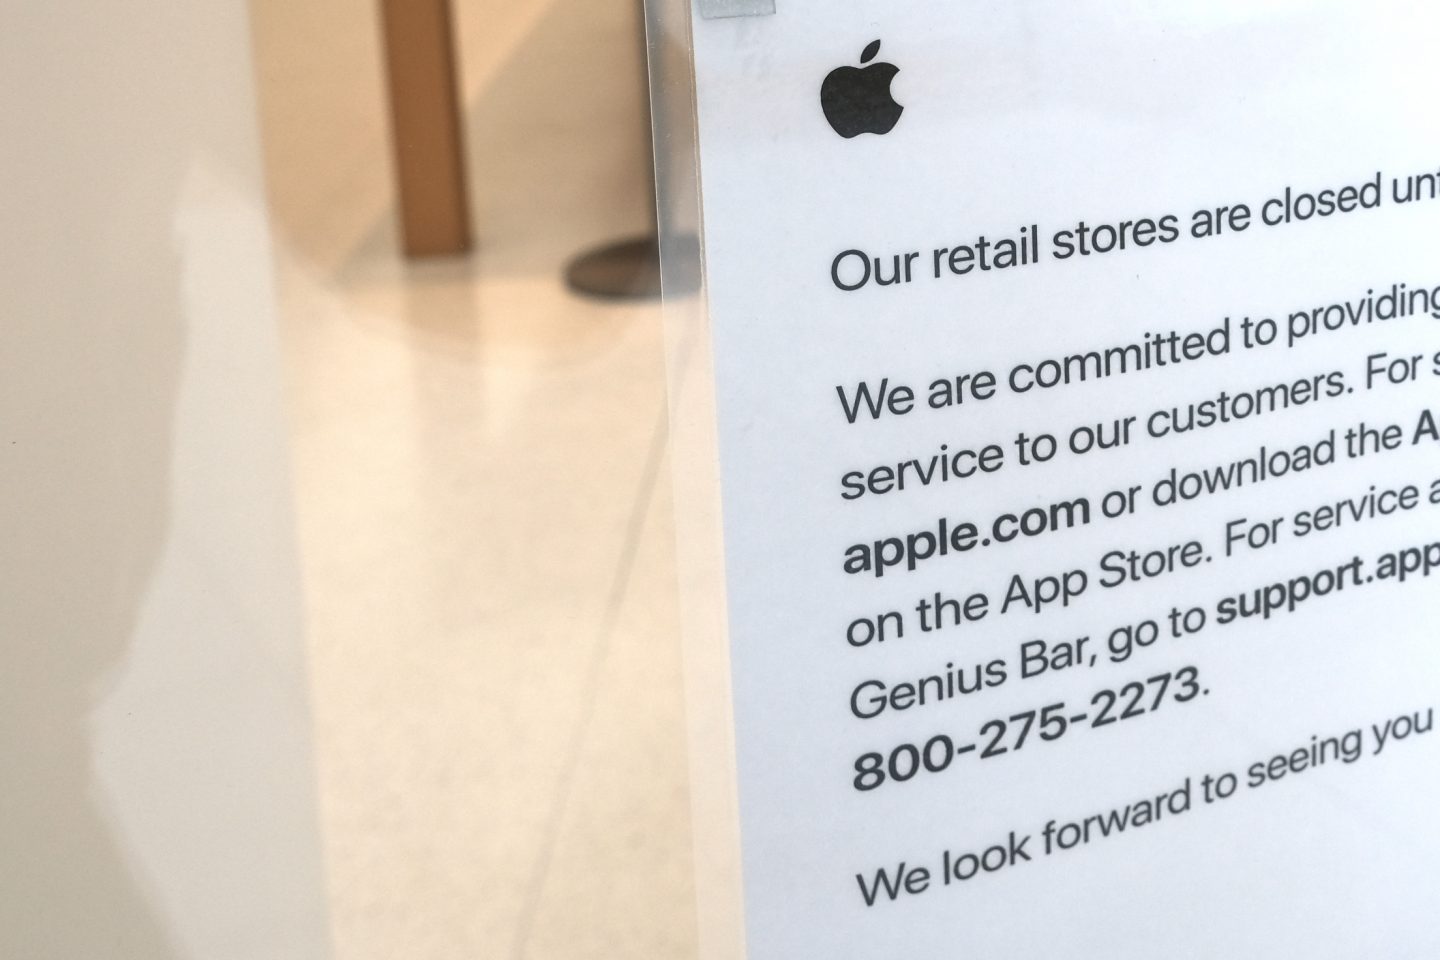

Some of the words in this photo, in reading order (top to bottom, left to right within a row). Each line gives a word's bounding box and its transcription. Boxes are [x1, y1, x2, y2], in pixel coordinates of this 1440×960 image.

[830, 248, 920, 292] Our
[933, 223, 1039, 279] retail
[1052, 214, 1180, 260] stores
[1190, 203, 1252, 239] are
[1261, 170, 1382, 227] closed
[835, 377, 915, 425] We
[927, 370, 997, 410] are
[1008, 316, 1231, 394] committed
[1239, 316, 1278, 350] to
[840, 443, 1005, 501] service
[1013, 432, 1058, 466] to
[1068, 415, 1137, 455] our
[1146, 370, 1354, 439] customers.
[1366, 351, 1424, 390] For
[843, 497, 1091, 579] apple.com
[1101, 484, 1143, 519] or
[1151, 428, 1336, 507] download
[1343, 421, 1403, 459] the
[846, 610, 904, 648] on
[914, 591, 990, 633] the
[1000, 568, 1089, 615] App
[1098, 540, 1213, 589] Store.
[1225, 516, 1285, 558] For
[1292, 484, 1420, 538] service
[849, 658, 1008, 720] Genius
[1020, 635, 1098, 680] Bar,
[1107, 619, 1160, 664] go
[1167, 606, 1207, 639] to
[852, 665, 1210, 792] 800-275-2273.
[855, 861, 931, 908] We
[942, 830, 1033, 886] look
[1041, 776, 1192, 856] forward
[1200, 772, 1238, 805] to
[1247, 728, 1363, 789] seeing
[1371, 707, 1434, 756] you
